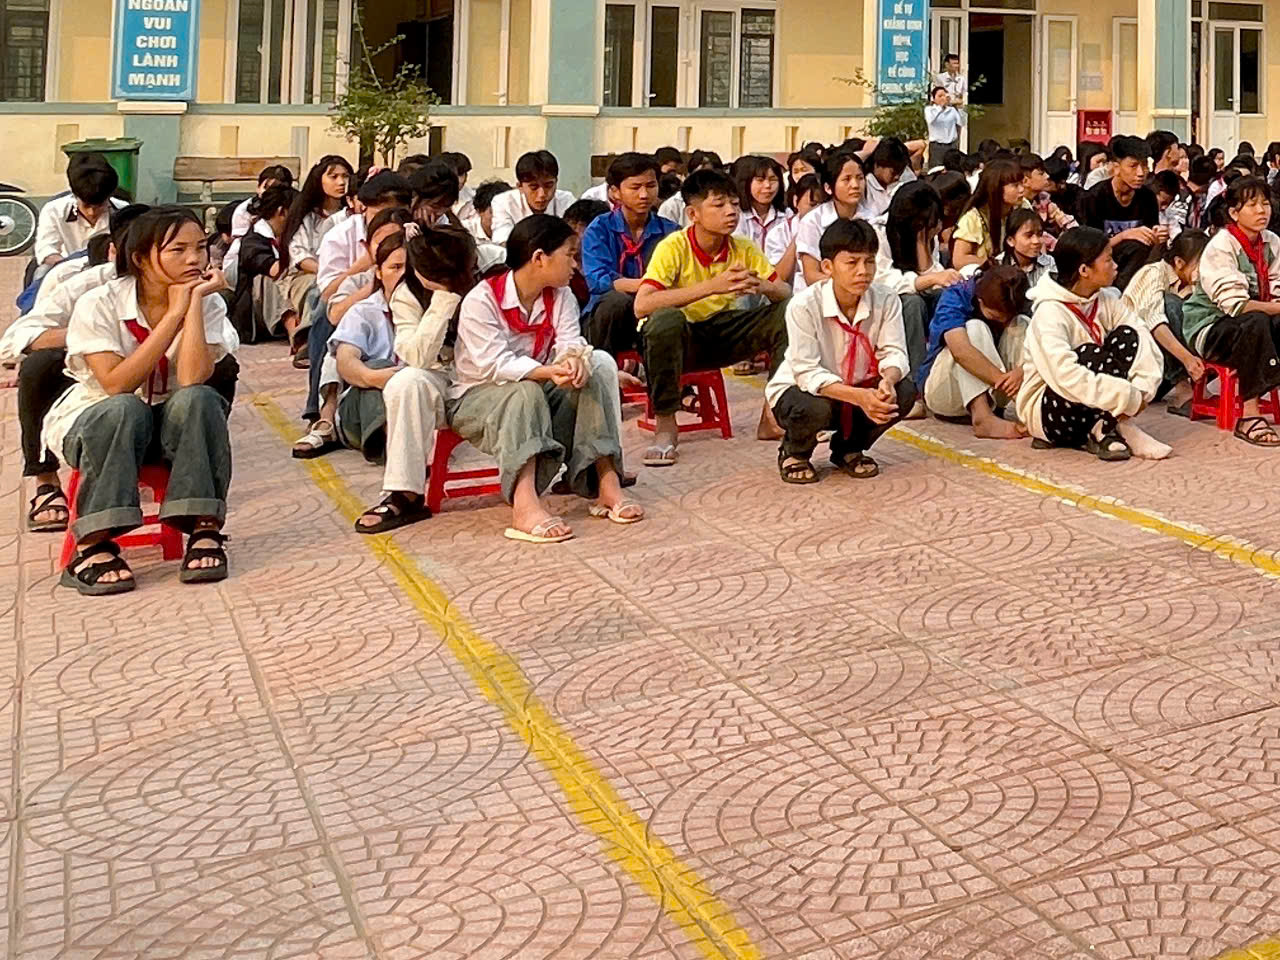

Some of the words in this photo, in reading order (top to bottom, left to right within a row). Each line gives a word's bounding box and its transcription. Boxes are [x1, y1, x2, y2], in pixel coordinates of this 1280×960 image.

[144, 16, 171, 30] VUI
[136, 35, 177, 49] CHƠI
[133, 53, 178, 68] LÀNH
[128, 73, 181, 88] MẠNH
